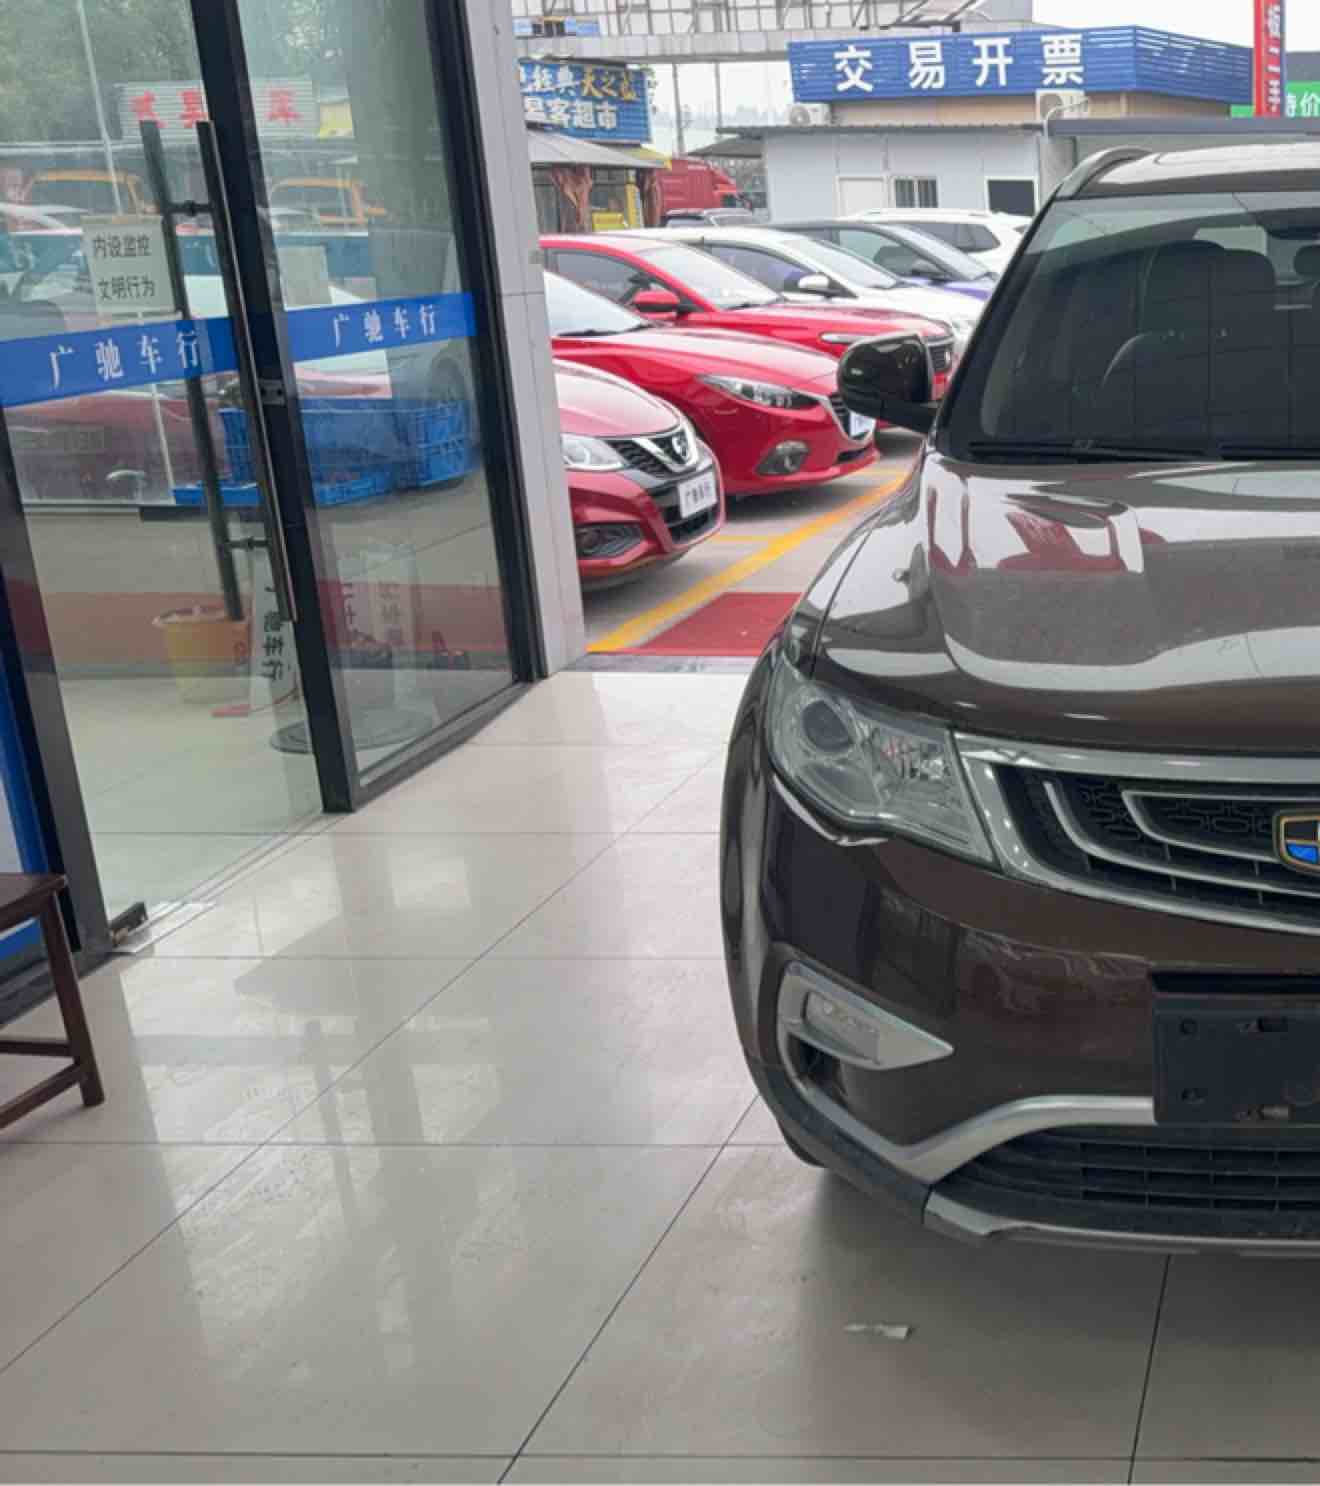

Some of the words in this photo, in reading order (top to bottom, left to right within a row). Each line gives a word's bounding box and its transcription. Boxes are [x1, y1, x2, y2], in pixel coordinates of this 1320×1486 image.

[833, 33, 1085, 92] 交易开票
[93, 234, 152, 258] 内设监控
[97, 275, 156, 300] 文明行为
[333, 304, 437, 348] 广驰车行
[49, 330, 199, 390] 广驰车行
